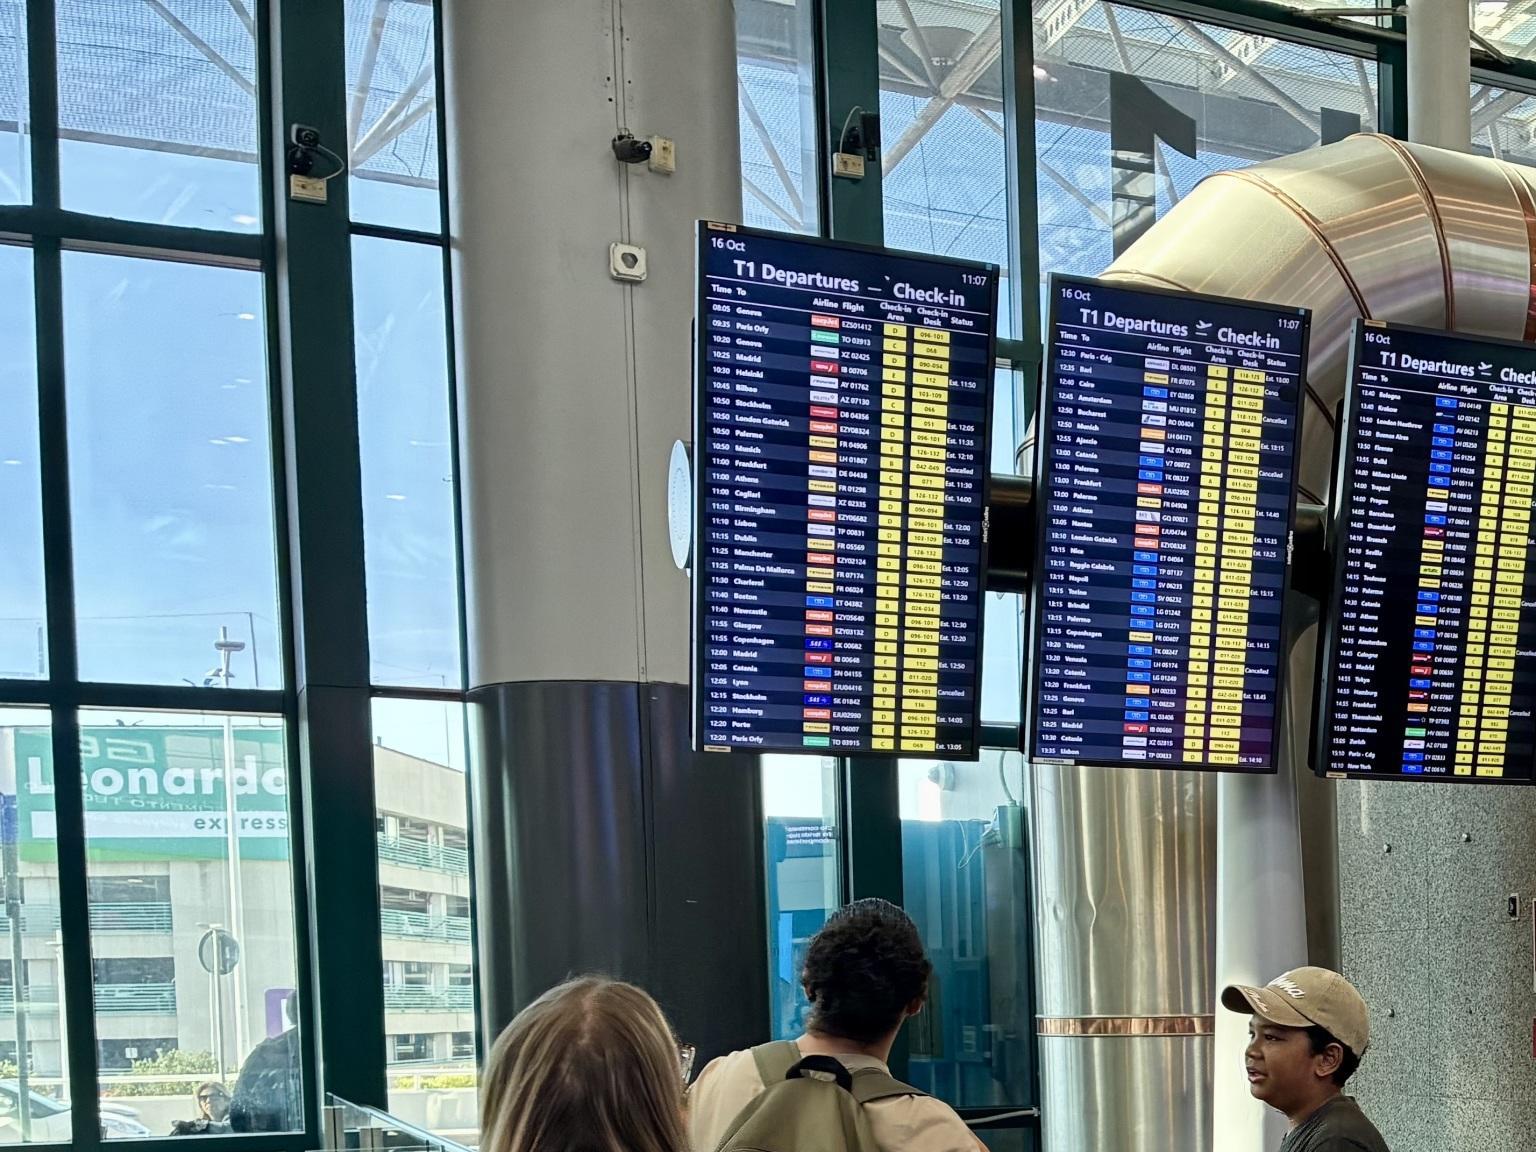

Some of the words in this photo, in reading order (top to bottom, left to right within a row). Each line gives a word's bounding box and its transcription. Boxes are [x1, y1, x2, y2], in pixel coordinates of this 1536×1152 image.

[711, 237, 724, 249] 16
[725, 239, 745, 252] Oct
[733, 259, 754, 277] T1
[761, 263, 858, 291] Departures
[893, 282, 964, 306] Check-in
[962, 273, 987, 286] 11:07
[711, 283, 732, 294] Time
[735, 286, 747, 296] To
[812, 297, 838, 308] Airline
[842, 301, 864, 312] Flight
[1061, 287, 1073, 298] 16
[1073, 289, 1091, 301] Oct
[950, 316, 973, 326] Status
[1079, 307, 1098, 324] T1
[1103, 311, 1188, 336] Departures
[1217, 327, 1279, 348] Check-in
[1278, 318, 1300, 329] 11:07
[1364, 332, 1375, 342] 16
[1375, 333, 1390, 344] Oct
[1379, 350, 1396, 366] T1
[1400, 354, 1474, 376] Departures
[194, 816, 288, 834] exress
